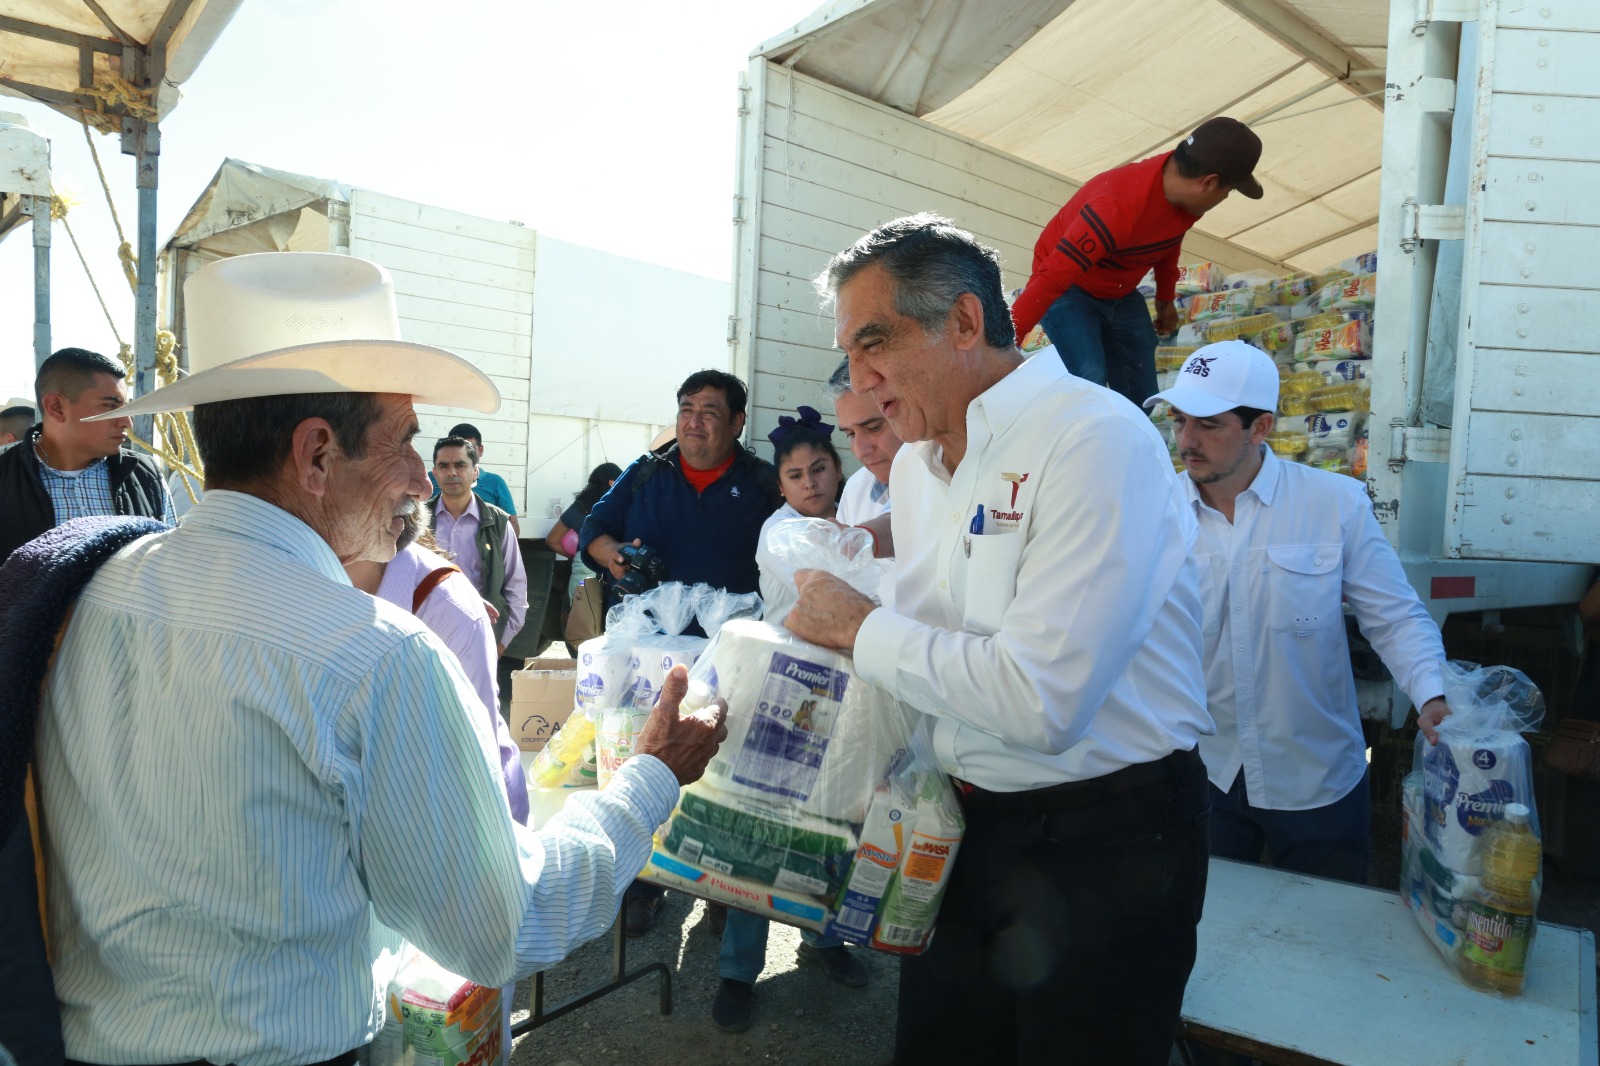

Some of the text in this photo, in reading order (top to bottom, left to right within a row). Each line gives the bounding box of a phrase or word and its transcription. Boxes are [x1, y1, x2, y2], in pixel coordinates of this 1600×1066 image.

[1075, 231, 1096, 254] 10
[784, 660, 831, 687] Premier
[1478, 751, 1490, 765] 4
[1456, 791, 1506, 818] Premi
[710, 876, 761, 902] Pionera
